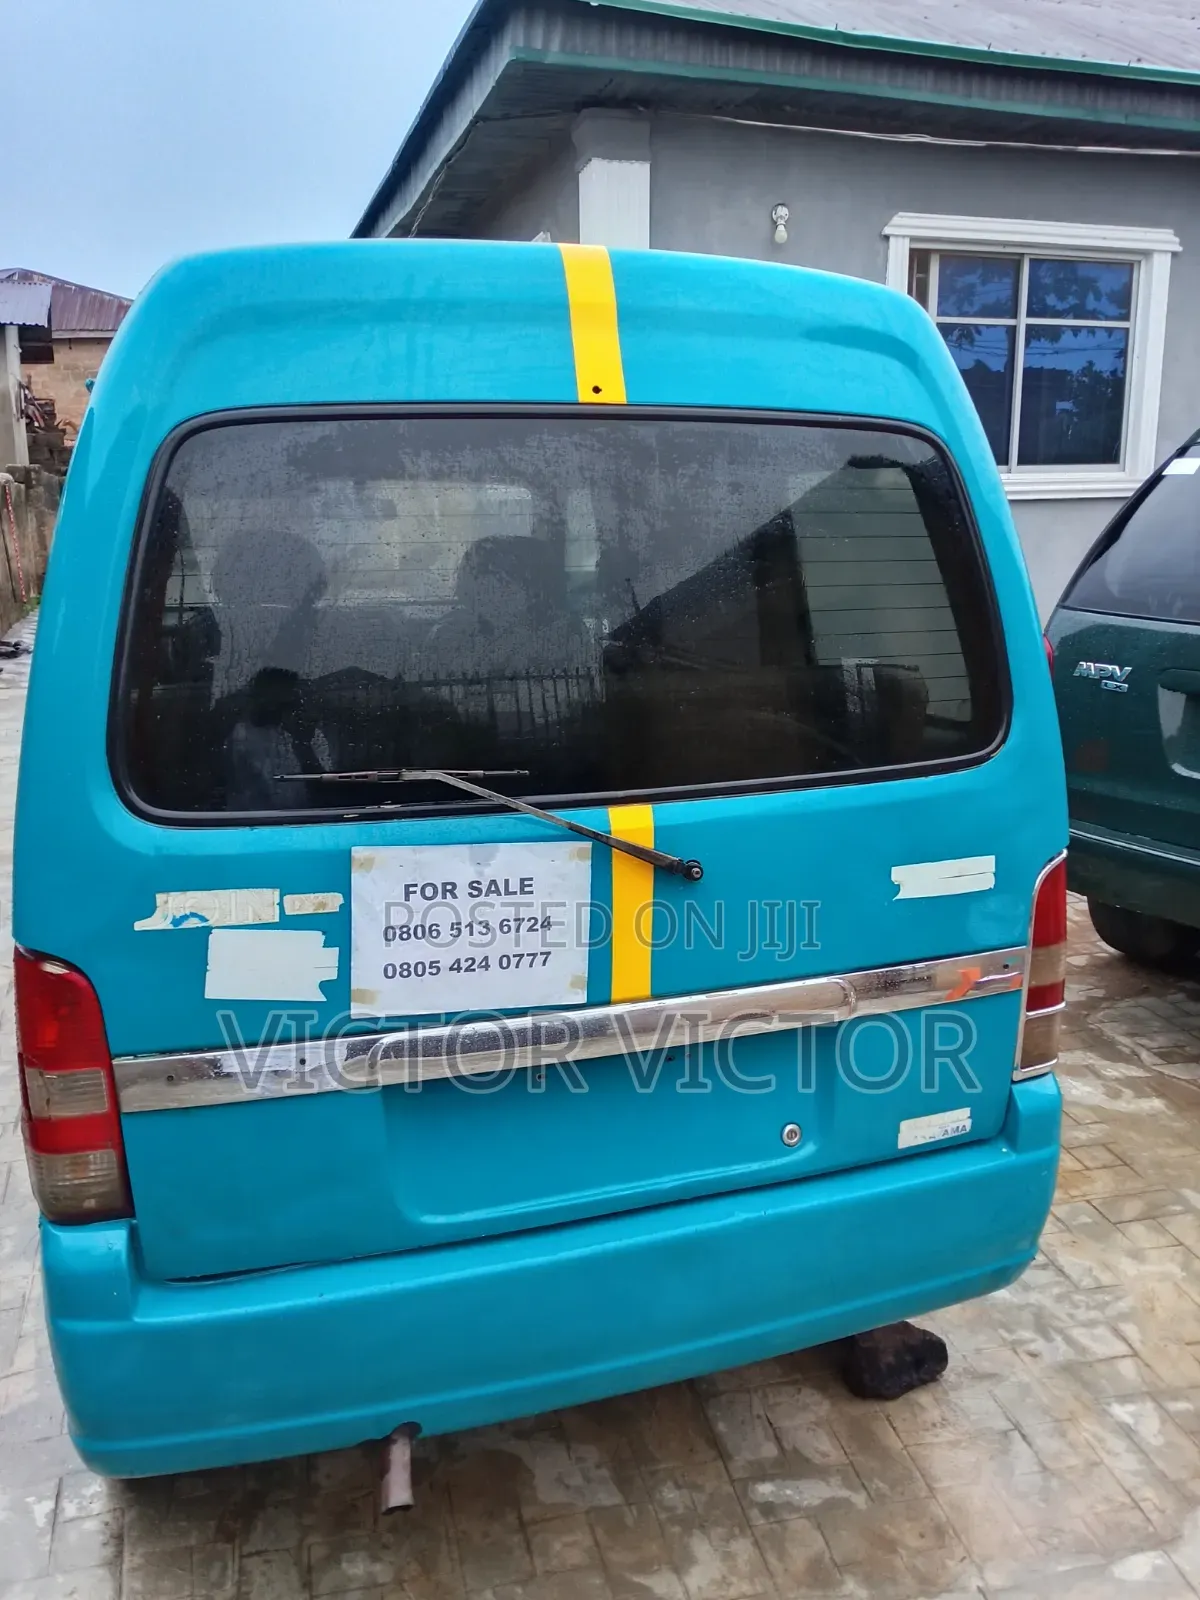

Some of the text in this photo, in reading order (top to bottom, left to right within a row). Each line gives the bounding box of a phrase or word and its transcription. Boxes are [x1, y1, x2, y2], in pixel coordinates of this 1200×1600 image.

[1073, 661, 1132, 681] MPV
[403, 877, 534, 901] FOR SALE
[383, 915, 553, 942] 0806 513 6724
[383, 951, 552, 979] 0805 424 0777
